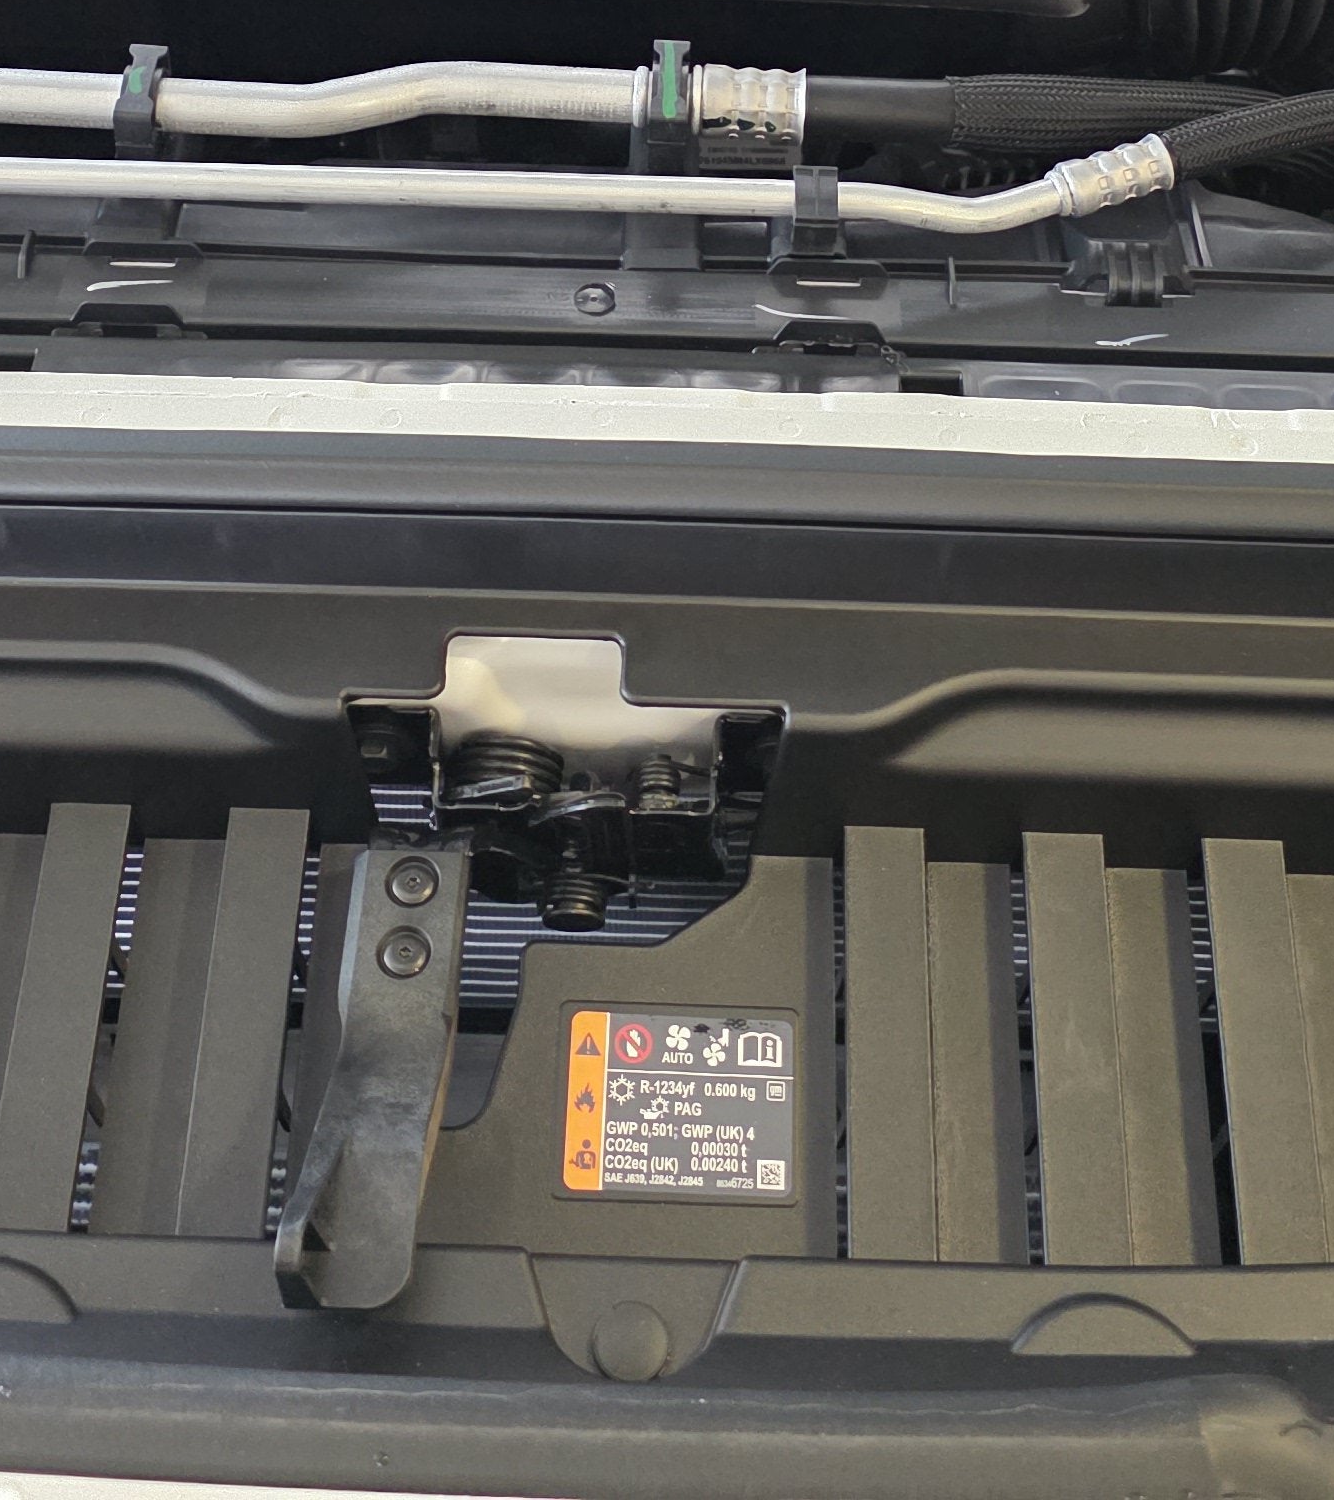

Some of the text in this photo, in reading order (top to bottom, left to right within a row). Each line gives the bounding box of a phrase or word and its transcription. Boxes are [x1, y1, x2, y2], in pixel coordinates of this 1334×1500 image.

[661, 1052, 694, 1065] AUTO
[640, 1079, 756, 1101] R-1234yf 0.600 kg
[674, 1102, 702, 1116] PAG
[606, 1121, 638, 1136] GWP
[681, 1124, 713, 1139] GWP
[716, 1125, 744, 1143] (UK)
[746, 1127, 755, 1140] 4
[605, 1138, 748, 1158] CO2eq 0,00030 t
[604, 1155, 748, 1175] CO2eq (UK) 0.00240 t
[604, 1172, 704, 1187] SAE J639, J2842, J2845
